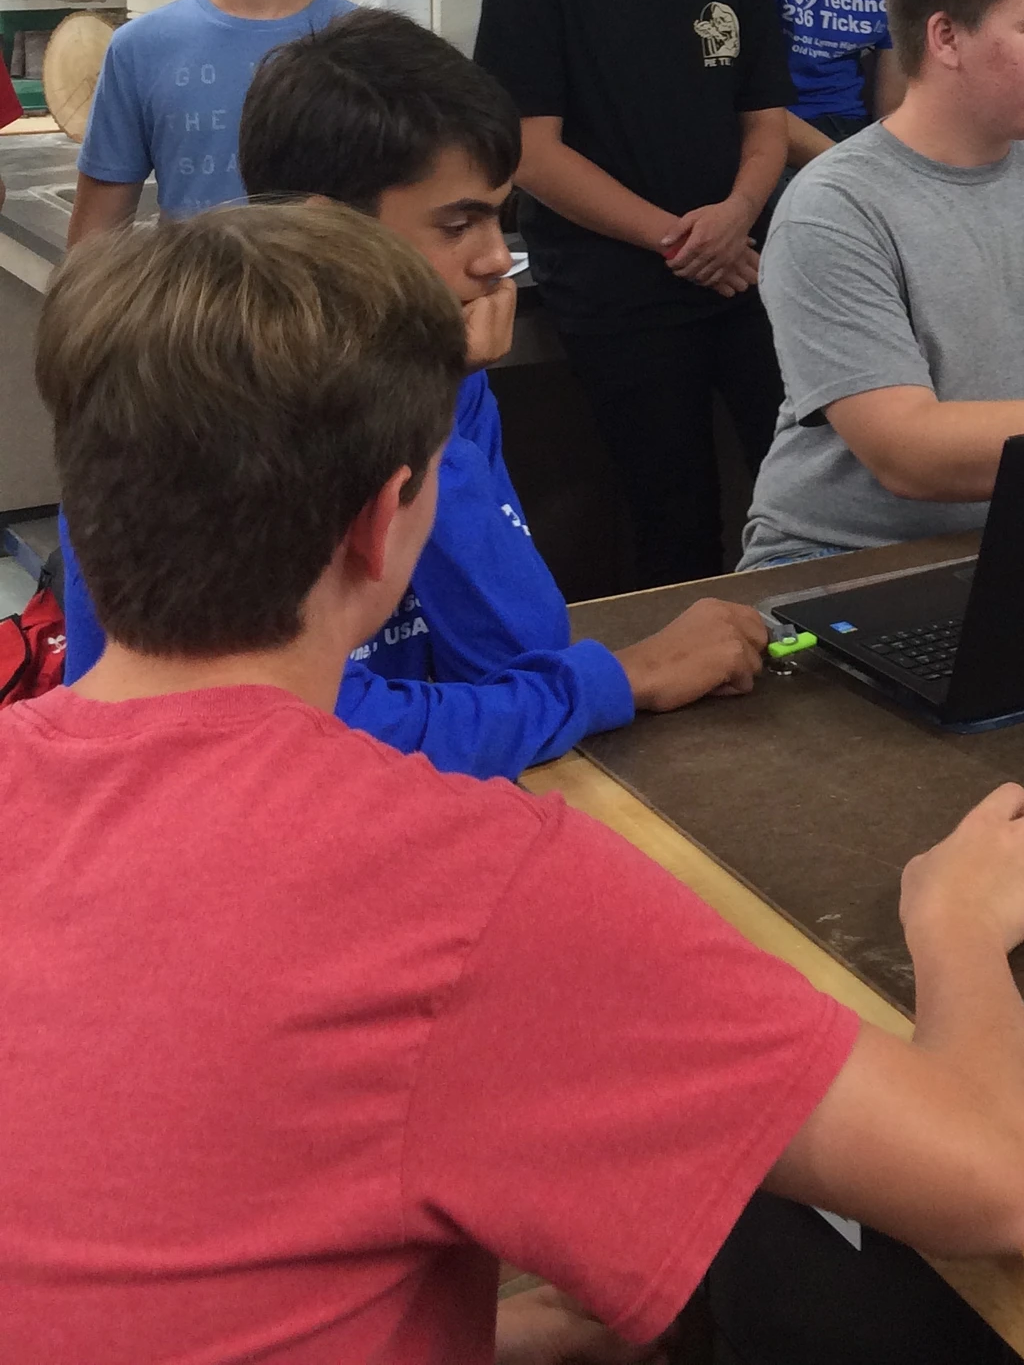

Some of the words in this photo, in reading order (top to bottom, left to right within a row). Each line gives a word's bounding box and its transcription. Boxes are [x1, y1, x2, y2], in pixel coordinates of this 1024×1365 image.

[782, 4, 814, 27] 236
[820, 10, 872, 34] Ticks
[175, 63, 216, 87] GO
[384, 616, 430, 645] USA
